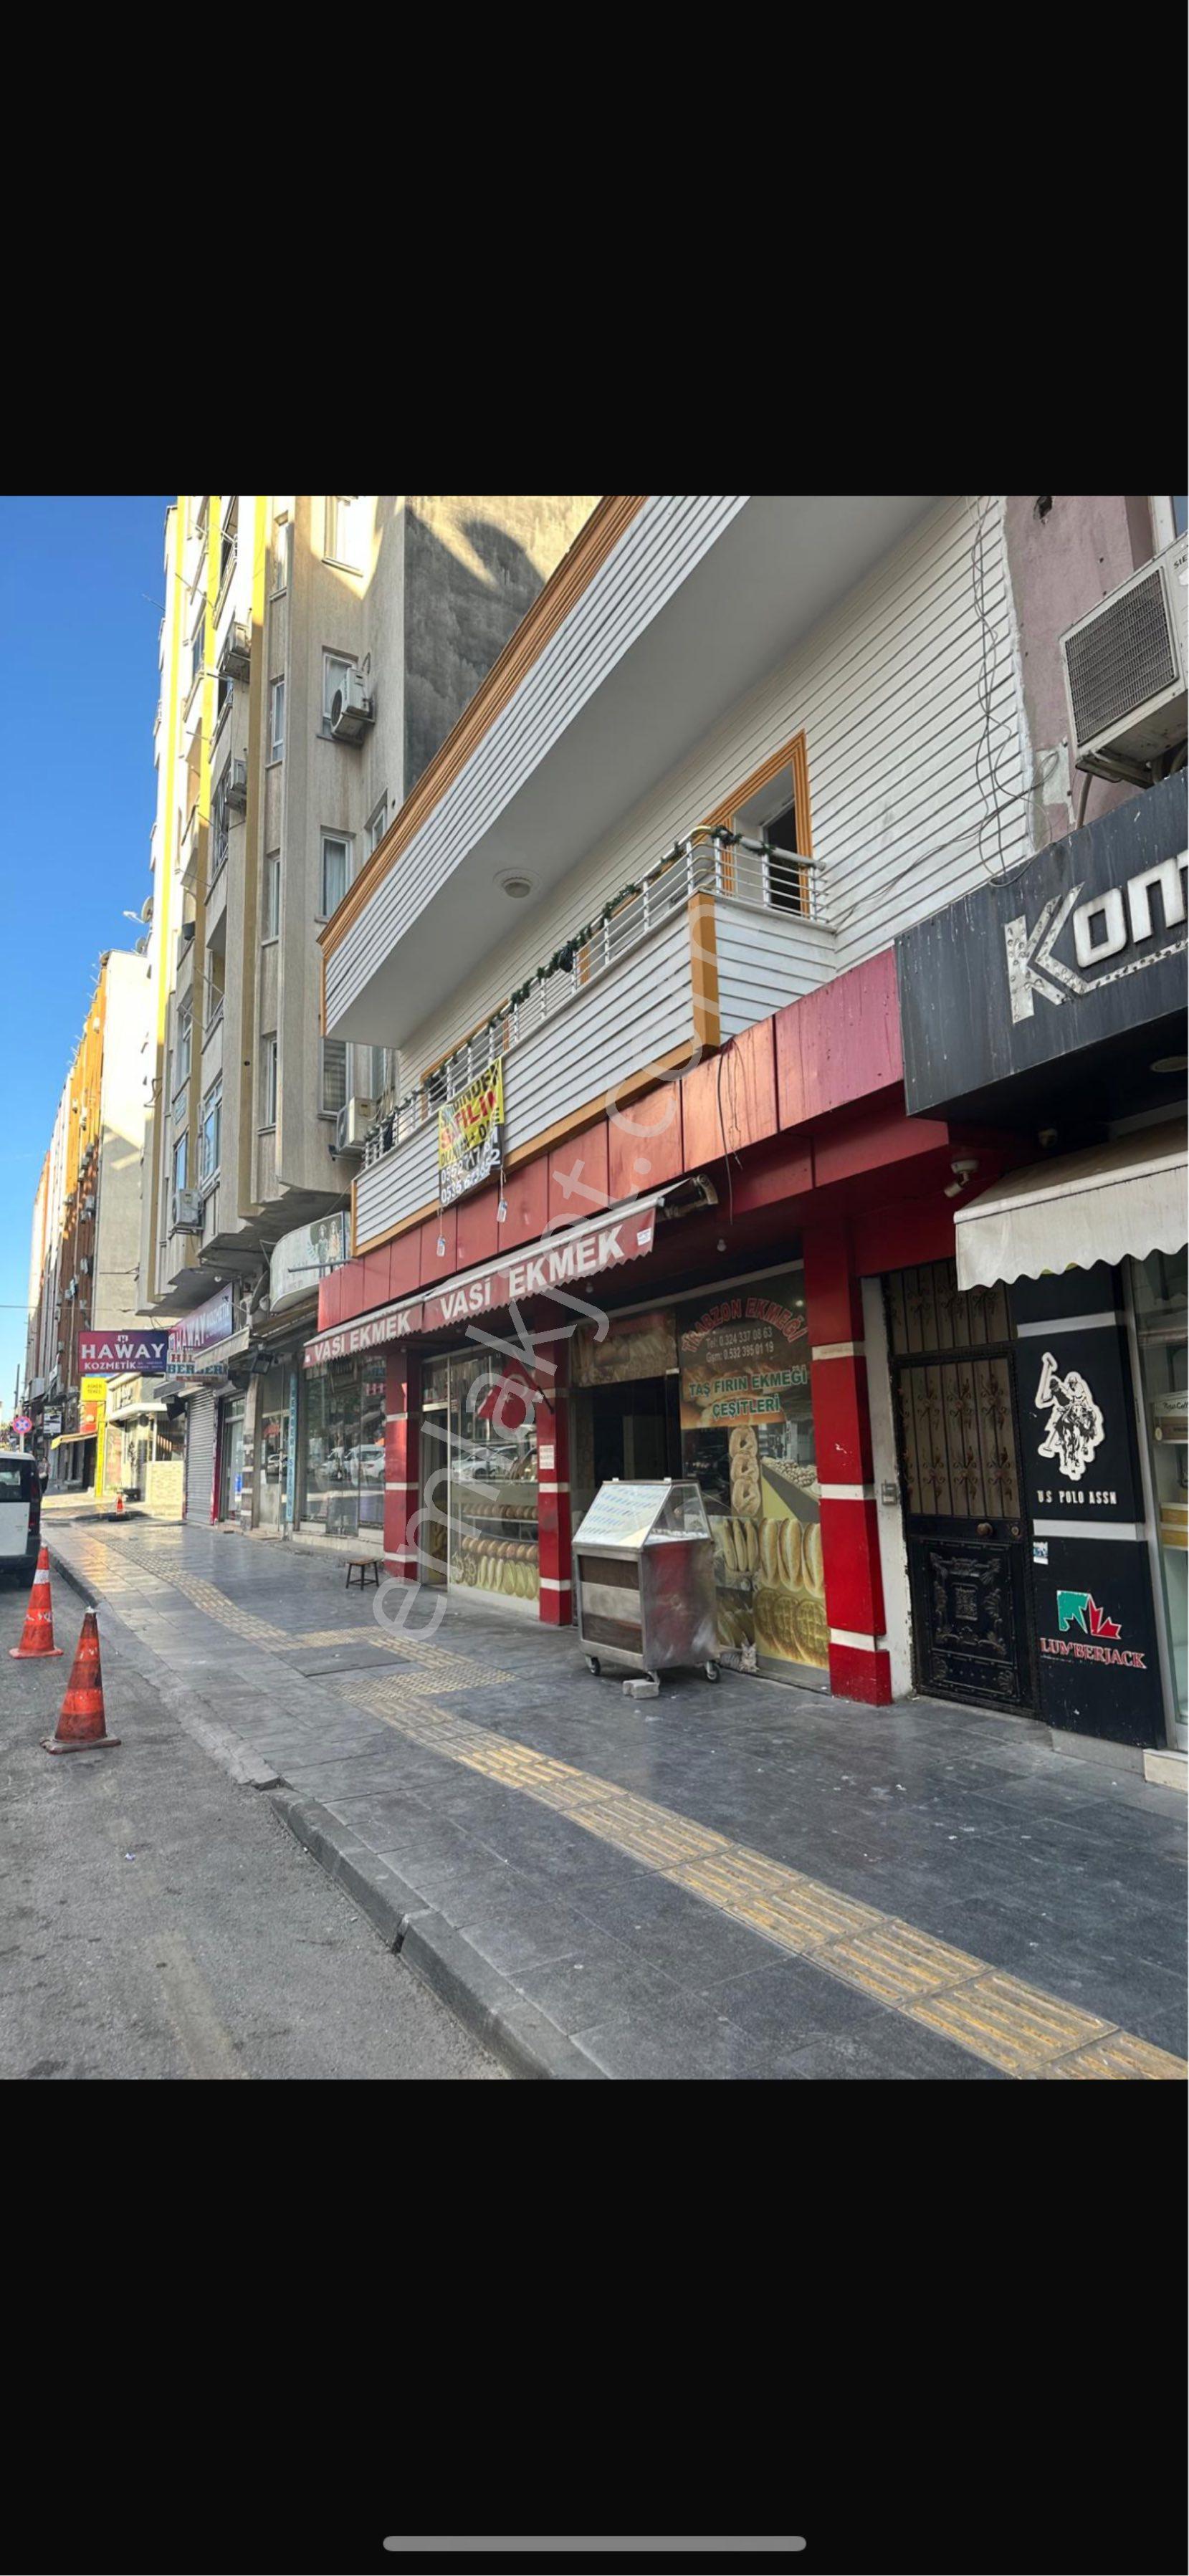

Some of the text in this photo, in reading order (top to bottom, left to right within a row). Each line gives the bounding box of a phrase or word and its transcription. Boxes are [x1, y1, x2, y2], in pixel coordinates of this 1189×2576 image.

[510, 1224, 625, 1298] EKMEK
[350, 1310, 411, 1351] EKMEK
[81, 1343, 165, 1359] HAWAY
[85, 1360, 136, 1370] KOZMETİK
[689, 1365, 808, 1398] TAŞ FIRIN EKMEĞİ
[712, 1394, 782, 1419] ÇEŞİTLERİ
[1059, 1490, 1084, 1503] POLO
[1089, 1491, 1117, 1505] ASSN
[1040, 1637, 1147, 1670] LUMBERJACK
